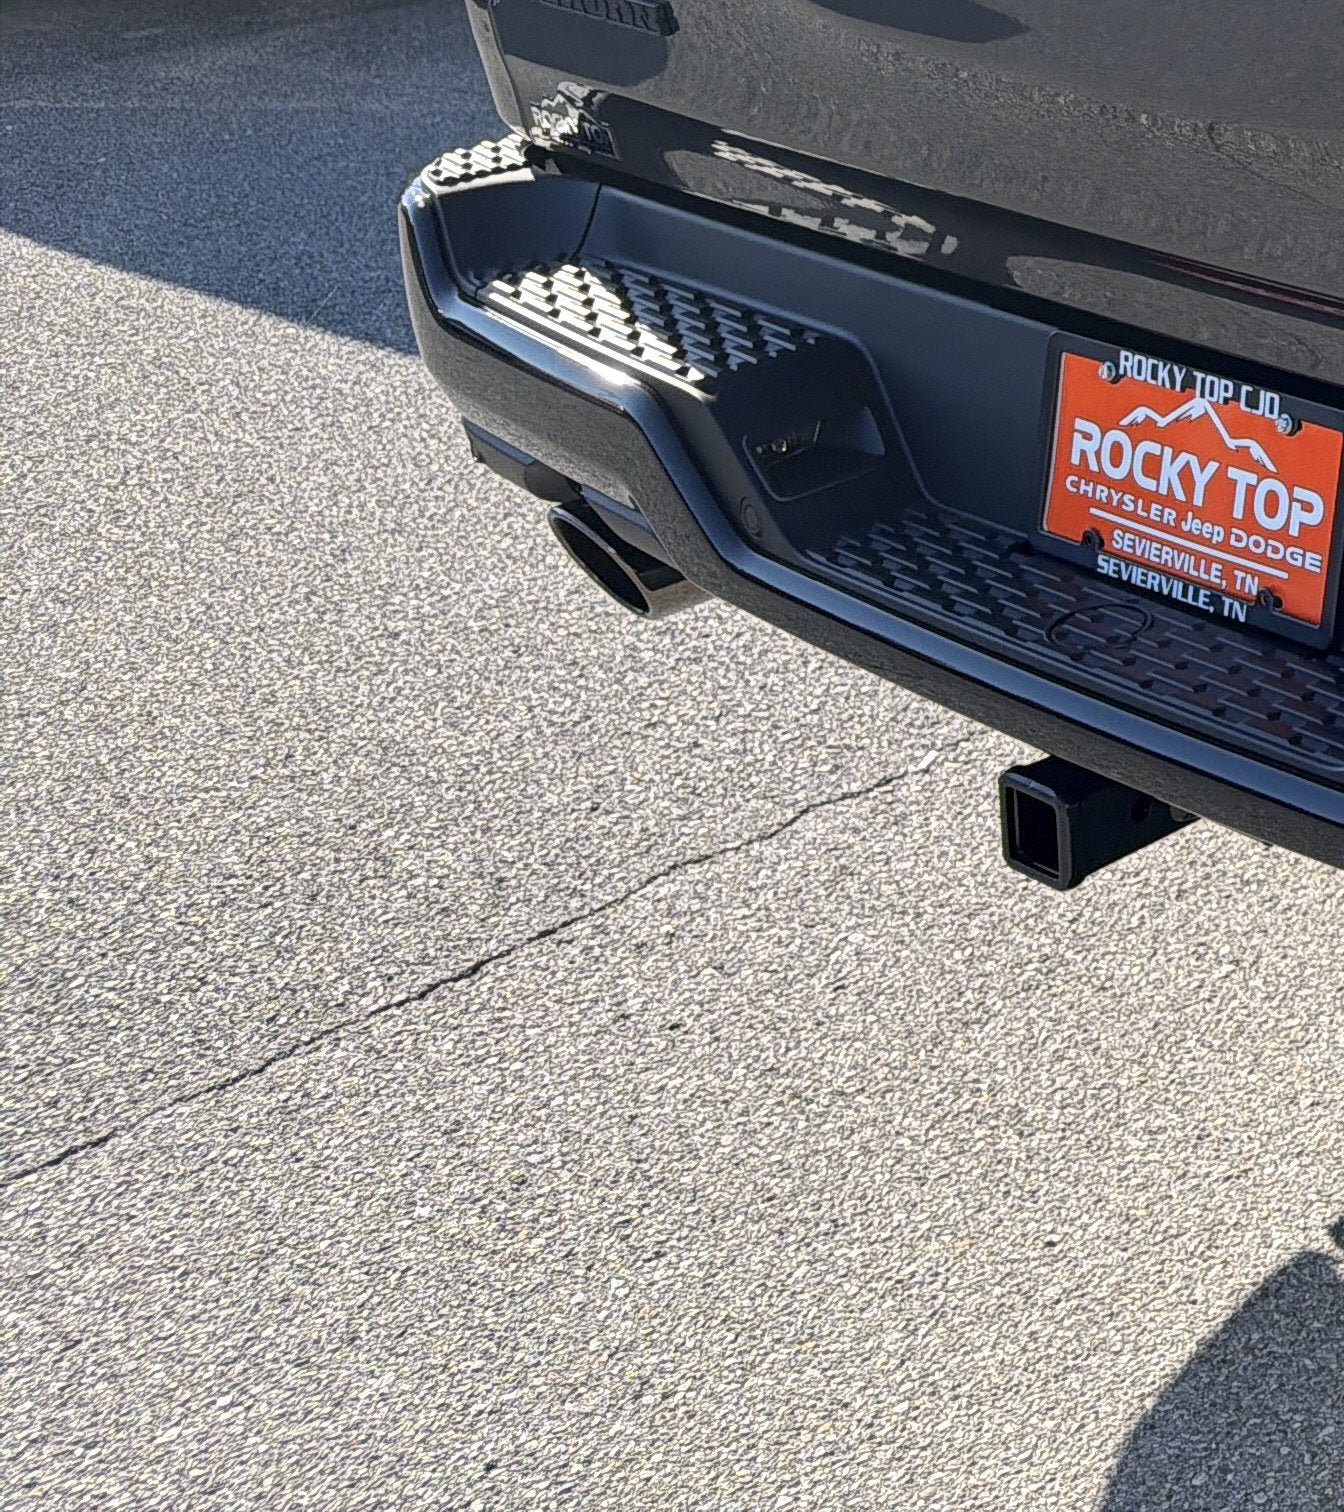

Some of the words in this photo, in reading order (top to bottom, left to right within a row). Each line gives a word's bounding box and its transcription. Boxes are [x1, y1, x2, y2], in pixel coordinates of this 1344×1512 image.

[1119, 350, 1187, 392] ROCKY
[1193, 371, 1234, 405] TOP
[1240, 385, 1280, 420] CJD
[1071, 417, 1220, 507] ROCKY
[1227, 466, 1325, 538] TOP
[1065, 475, 1177, 526] CHRYSLER
[1181, 512, 1225, 544] Jeep
[1230, 528, 1323, 573] DODGE
[1097, 553, 1215, 614] SEVIERVILLE,
[1221, 594, 1247, 623] TN
[1112, 529, 1227, 589] SEVIERVILLE,
[1234, 569, 1260, 597] TN
